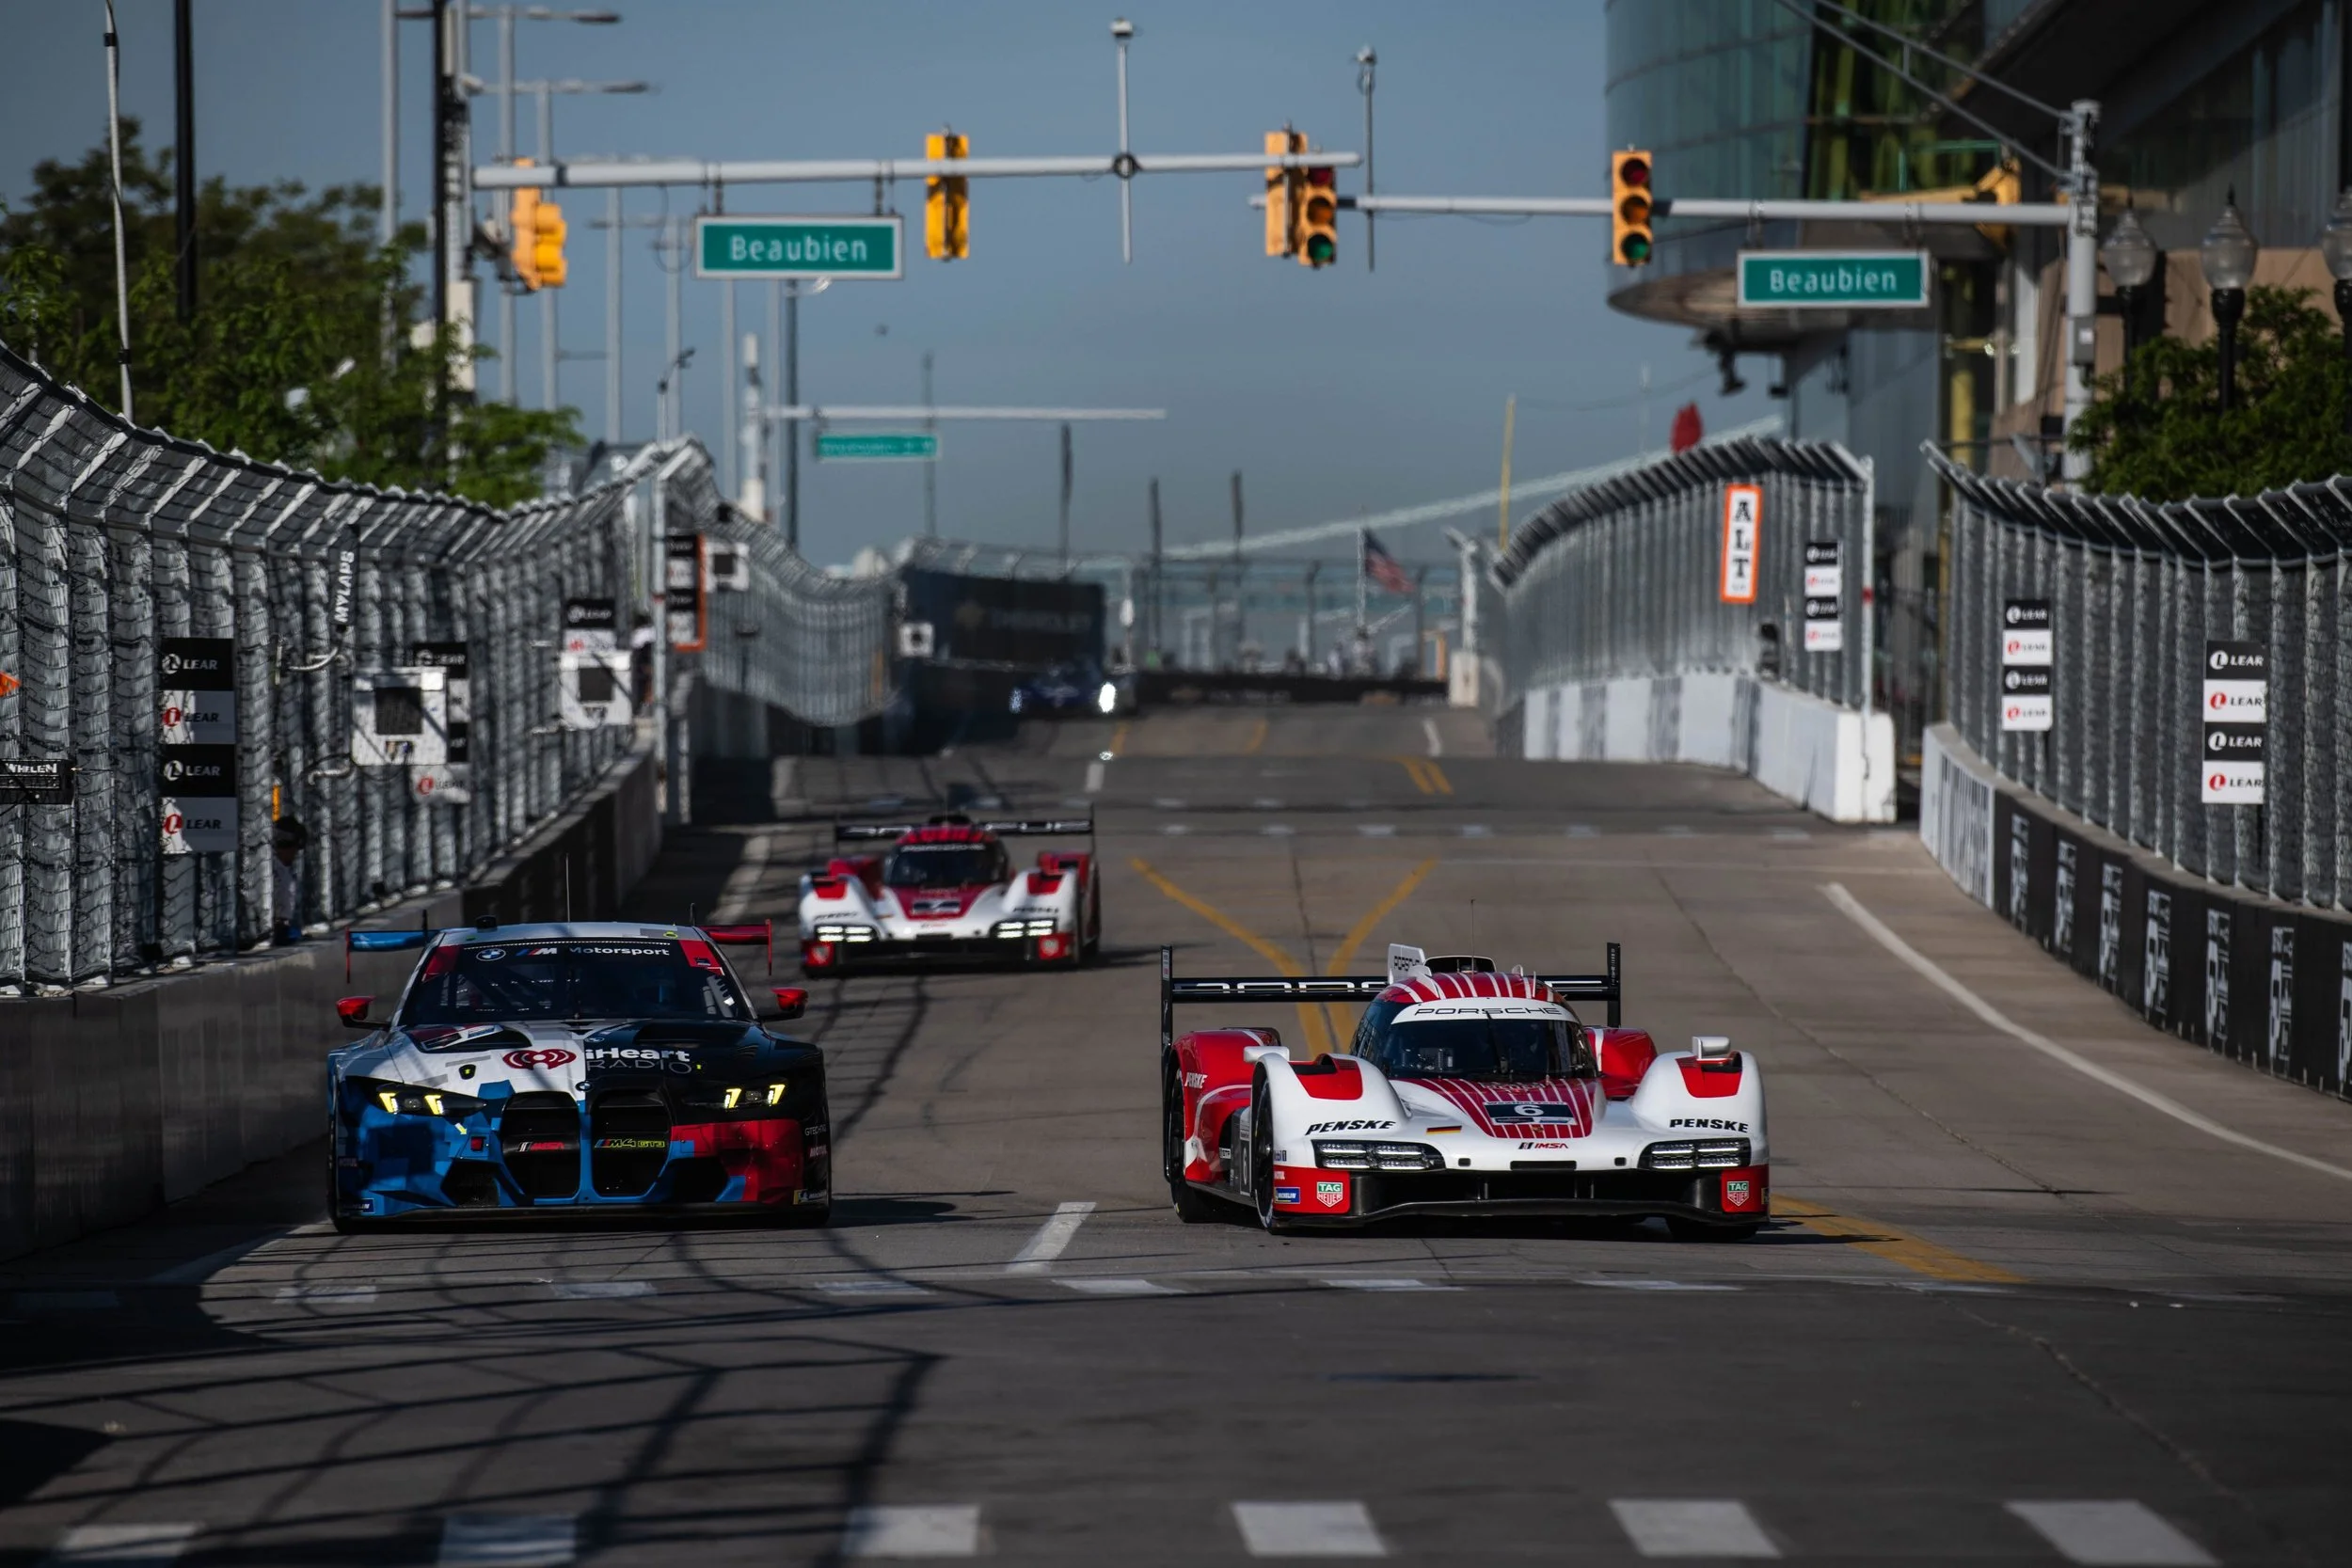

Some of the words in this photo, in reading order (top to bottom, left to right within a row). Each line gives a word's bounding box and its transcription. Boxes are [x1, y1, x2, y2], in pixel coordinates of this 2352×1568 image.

[730, 234, 867, 261] Beaubien
[1770, 266, 1898, 293] Beaubien
[1733, 500, 1751, 578] ALT
[334, 550, 355, 623] MYLAPS
[183, 659, 217, 670] LEAR
[2230, 655, 2264, 667] LEAR
[2231, 697, 2263, 706] LEAR
[184, 713, 219, 723] LEAR
[2229, 736, 2263, 748] LEAR
[185, 766, 220, 776] LEAR
[2230, 779, 2264, 788] LEAR
[186, 819, 221, 830] LEAR
[569, 947, 670, 956] Motorsport
[1414, 1007, 1562, 1017] PORSCHE
[585, 1047, 691, 1062] iHeart
[586, 1059, 692, 1074] RADIO
[1514, 1104, 1544, 1117] 6
[1305, 1119, 1396, 1136] PENSKE
[1670, 1118, 1748, 1132] PENSKE
[1319, 1183, 1341, 1192] TAG
[1317, 1193, 1342, 1206] HEUER
[1727, 1192, 1748, 1205] HEUER
